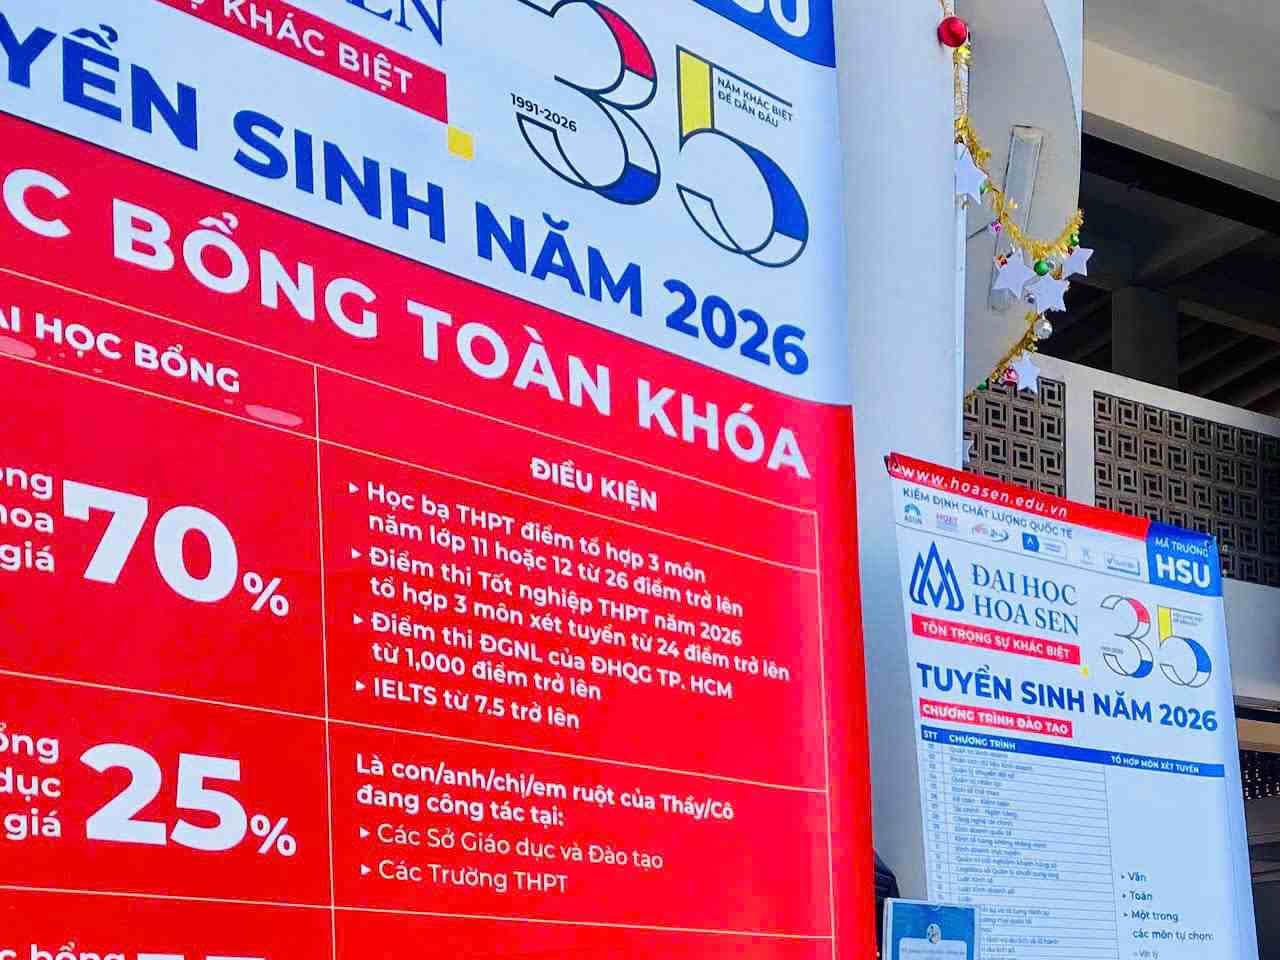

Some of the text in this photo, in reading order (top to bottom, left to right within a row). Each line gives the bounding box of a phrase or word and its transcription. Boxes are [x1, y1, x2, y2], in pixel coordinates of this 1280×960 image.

[223, 0, 326, 58] KHÁC
[338, 41, 413, 92] BIỆT
[510, 93, 578, 132] 1991-2026
[718, 76, 792, 121] NĂM KHÁC BIỆT
[233, 110, 447, 244] SINH
[475, 211, 643, 317] NĂM
[664, 279, 810, 375] 2026
[35, 313, 122, 359] HỌC
[135, 342, 239, 392] BỔNG
[113, 199, 810, 478] BỔNG TOÀN KHÓA
[530, 458, 656, 511] ĐIỀU KIỆN
[900, 466, 1068, 518] www.hoasen.edu.vn
[63, 480, 288, 616] 70%
[368, 482, 705, 582] Học bạ THPT điểm tổ hợp 3 môn
[1155, 554, 1211, 589] HSU
[921, 620, 1070, 659] TÔN TRỌNG SỰ KHÁC BIỆT
[973, 593, 1079, 635] HOA SEN
[371, 612, 732, 698] Điểm thi ĐGNL của ĐHQG TP. HCM
[375, 678, 579, 728] IELTS từ 7.5 trở lên
[916, 662, 1218, 732] TUYỂN SINH NĂM 2026
[922, 704, 975, 721] CHƯƠNG
[978, 711, 1014, 726] TRÌNH
[1017, 717, 1042, 731] ĐÀO
[923, 730, 938, 740] STT
[80, 744, 296, 856] 25%
[357, 754, 733, 819] Là con/anh/chị/em ruột của Thầy/Cô
[378, 824, 662, 868] Các Sở Giáo dục và Đào tạo
[1130, 891, 1152, 901] Toán
